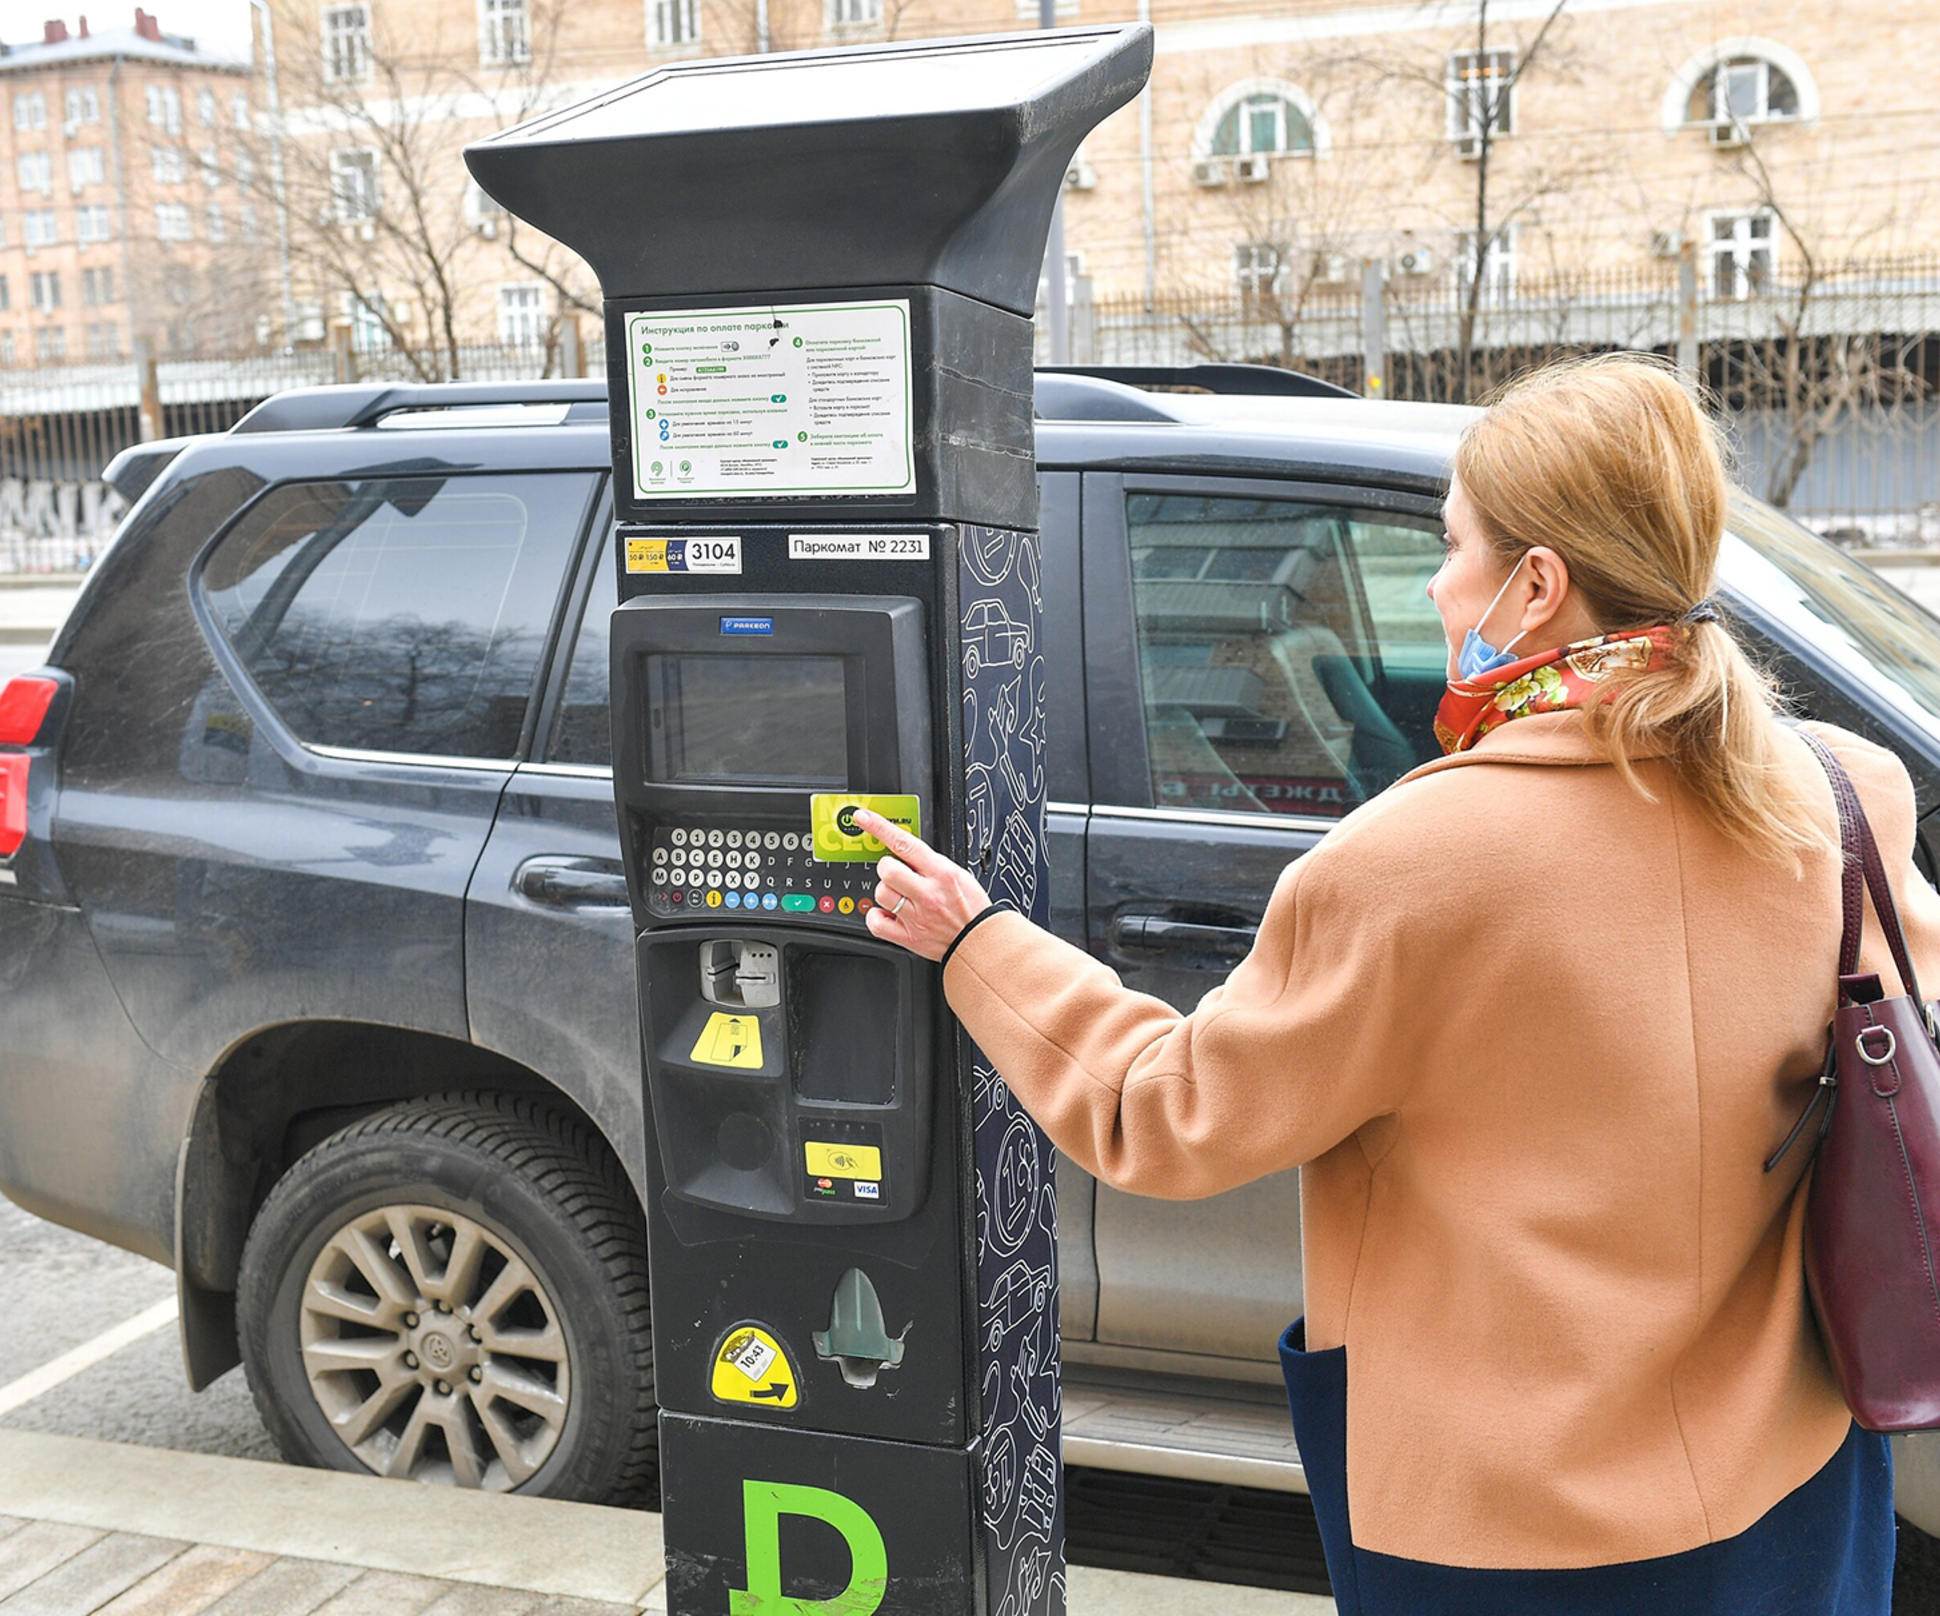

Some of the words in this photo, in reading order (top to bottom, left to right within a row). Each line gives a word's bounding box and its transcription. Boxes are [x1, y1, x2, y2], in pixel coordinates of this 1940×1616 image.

[640, 324, 694, 337] Инструкция
[696, 324, 708, 333] по
[709, 323, 741, 332] оплате
[744, 321, 789, 332] паркои
[645, 345, 649, 353] 1
[645, 358, 650, 366] 2
[649, 410, 654, 418] 3
[800, 433, 806, 441] 5
[692, 542, 736, 560] 3104
[793, 540, 862, 556] Паркомат
[868, 540, 886, 554] №
[890, 540, 924, 554] 2231
[667, 553, 677, 561] 60
[733, 621, 771, 630] PARKEON
[676, 833, 682, 841] 0
[694, 833, 700, 842] 1
[713, 834, 719, 843] 2
[731, 834, 738, 844] 3
[750, 835, 756, 844] 4
[768, 835, 775, 845] 5
[787, 836, 794, 846] 6
[856, 1184, 878, 1195] VISA
[740, 1344, 765, 1369] 10:43
